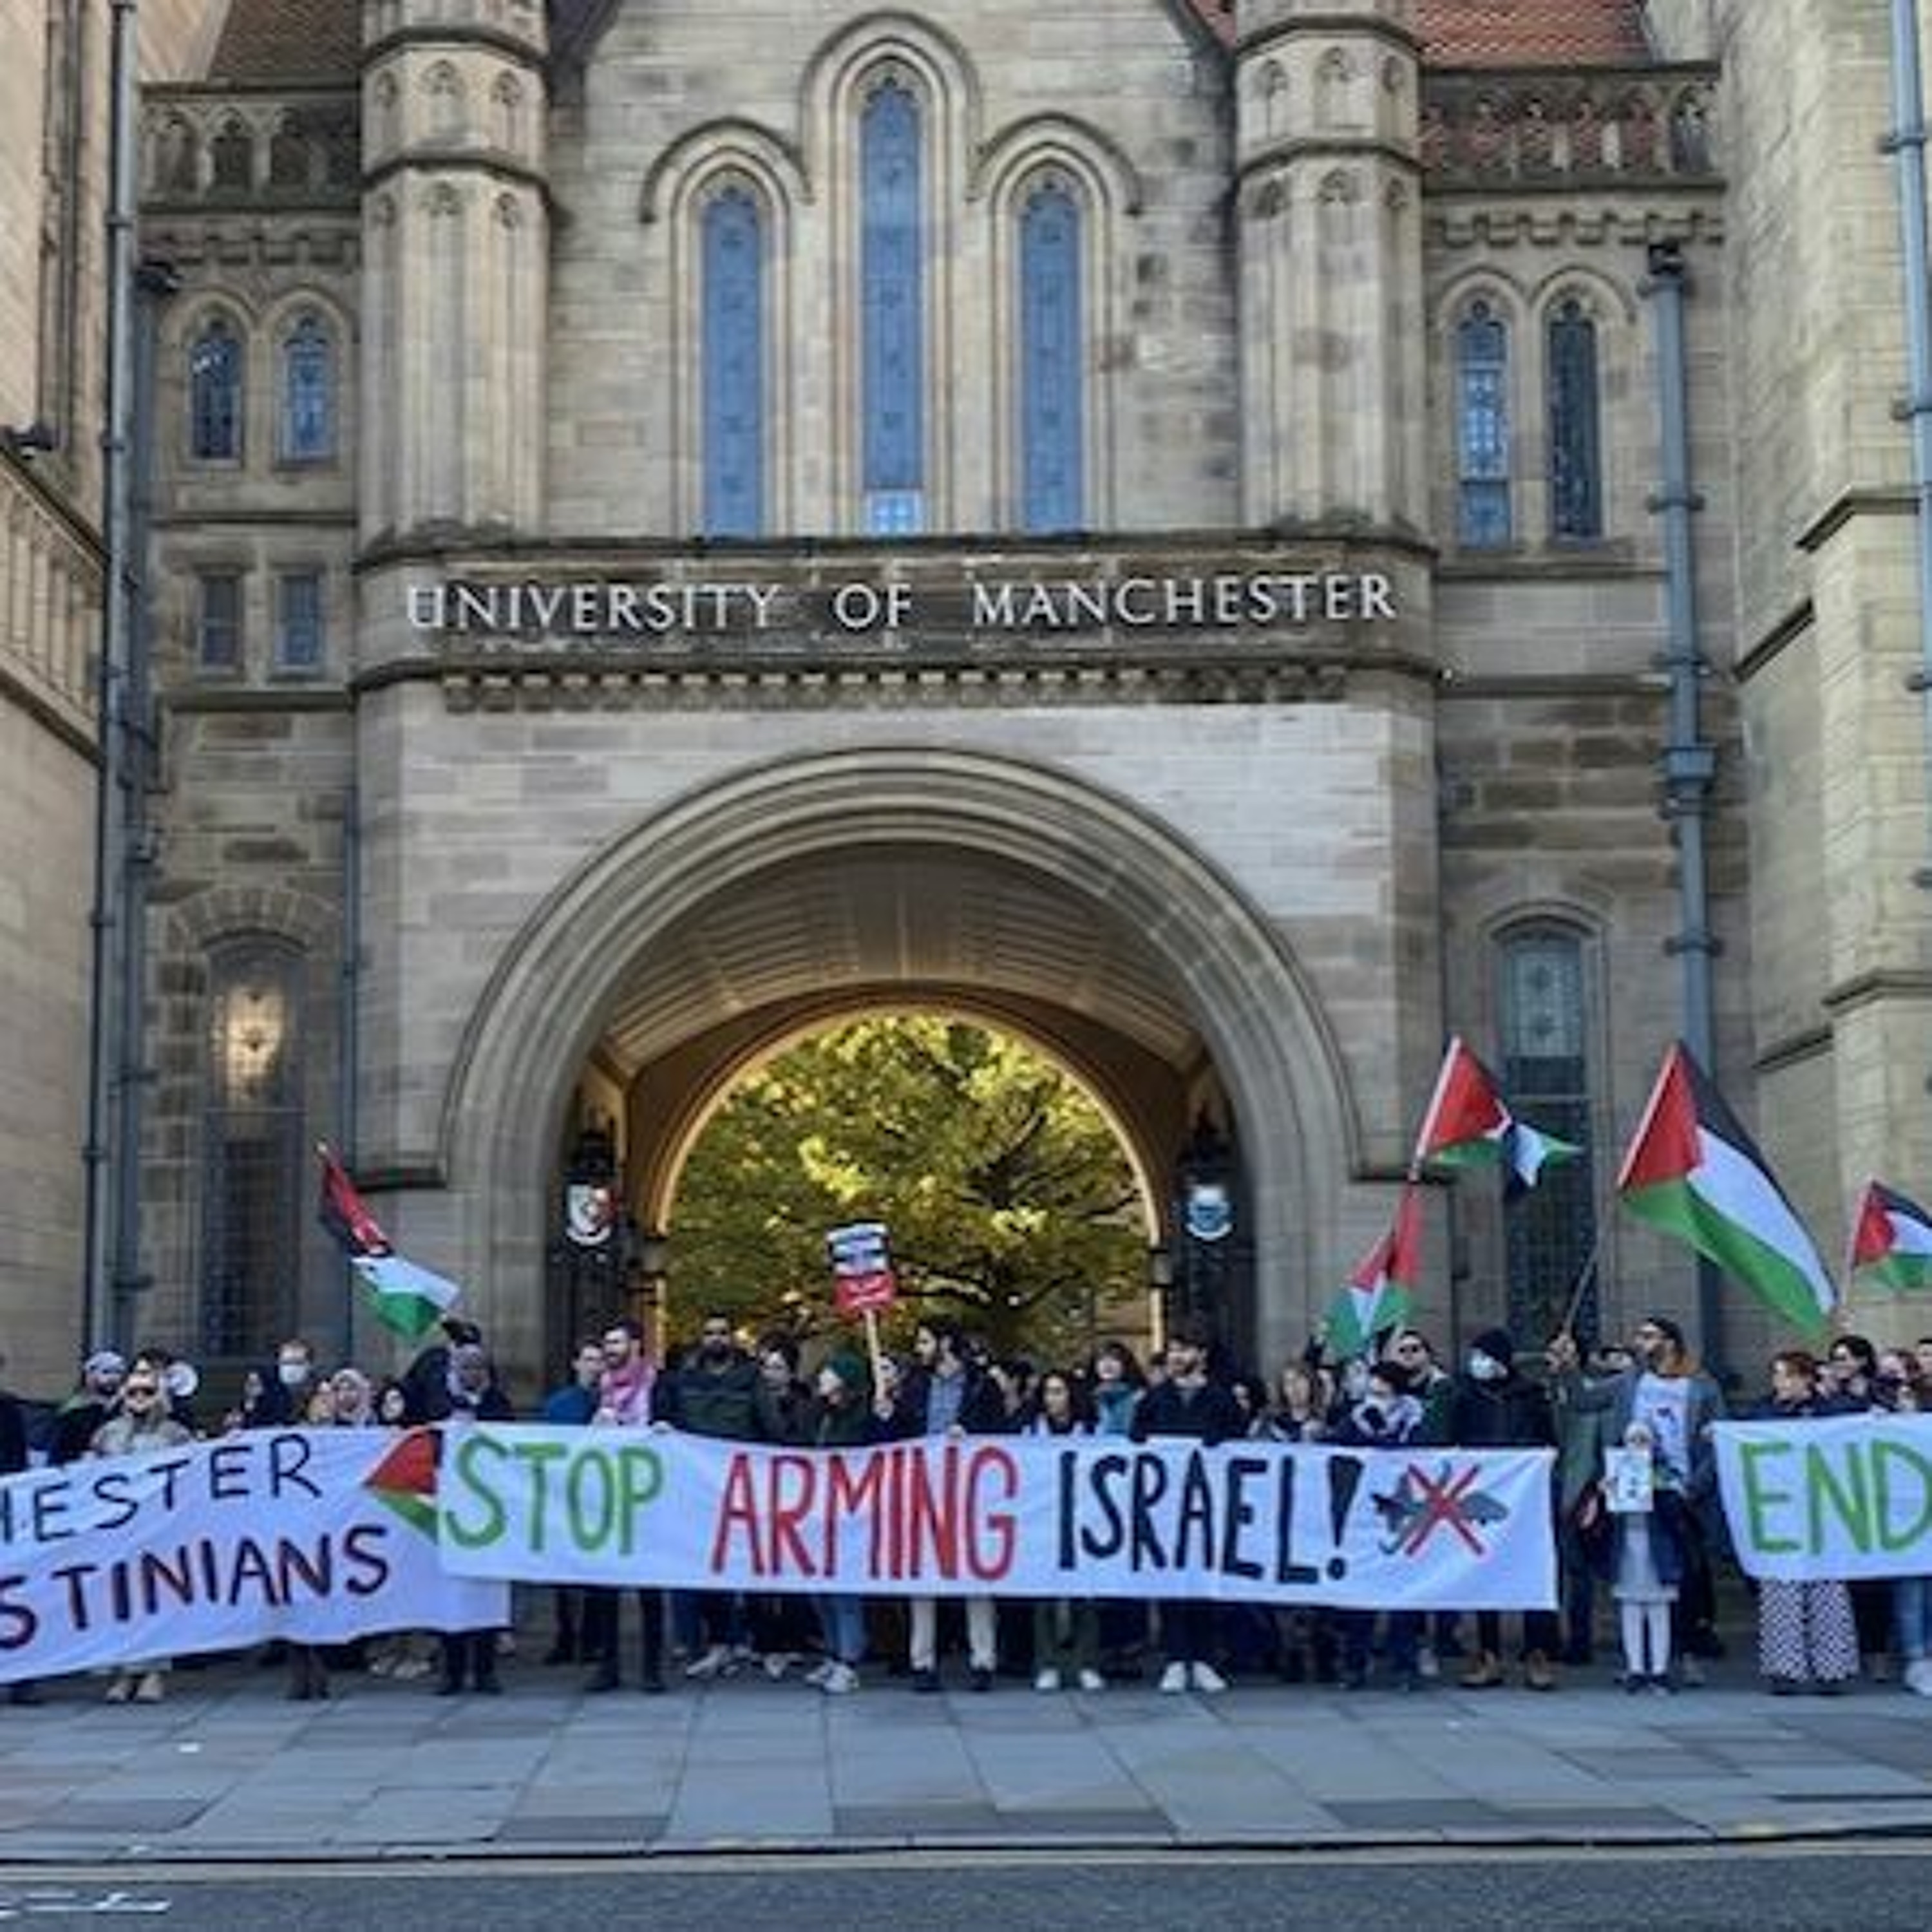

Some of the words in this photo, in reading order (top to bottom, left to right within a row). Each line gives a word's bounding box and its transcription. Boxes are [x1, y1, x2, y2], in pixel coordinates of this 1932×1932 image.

[406, 583, 782, 630] UNIVERSITY
[834, 583, 912, 630] OF
[972, 573, 1396, 626] MANCHESTER
[446, 1434, 664, 1555] STOP
[711, 1444, 1018, 1580] ARMING
[1059, 1449, 1364, 1584] ISRAEL!
[1741, 1440, 1932, 1556] END
